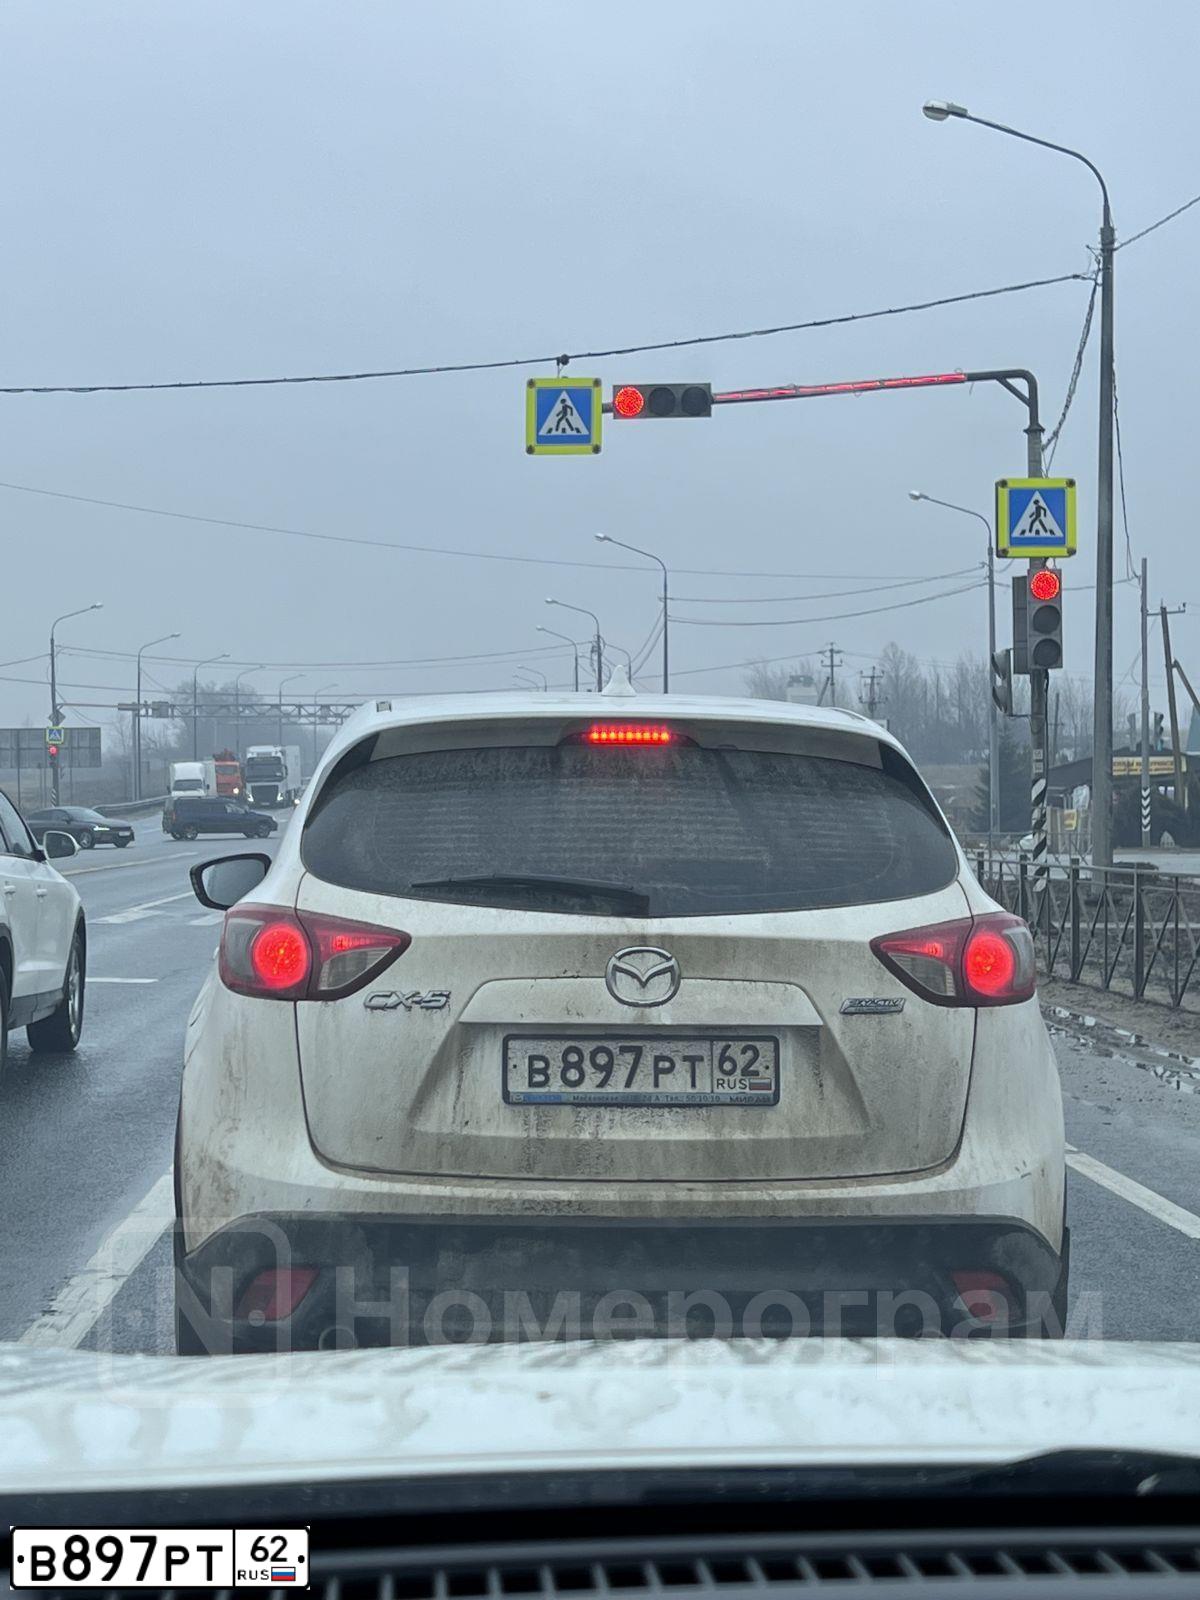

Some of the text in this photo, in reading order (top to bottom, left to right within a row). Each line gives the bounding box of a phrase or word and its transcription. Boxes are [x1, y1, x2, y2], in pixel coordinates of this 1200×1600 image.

[363, 989, 451, 1010] CX-5
[718, 1044, 760, 1077] 62
[716, 1078, 748, 1090] RUS
